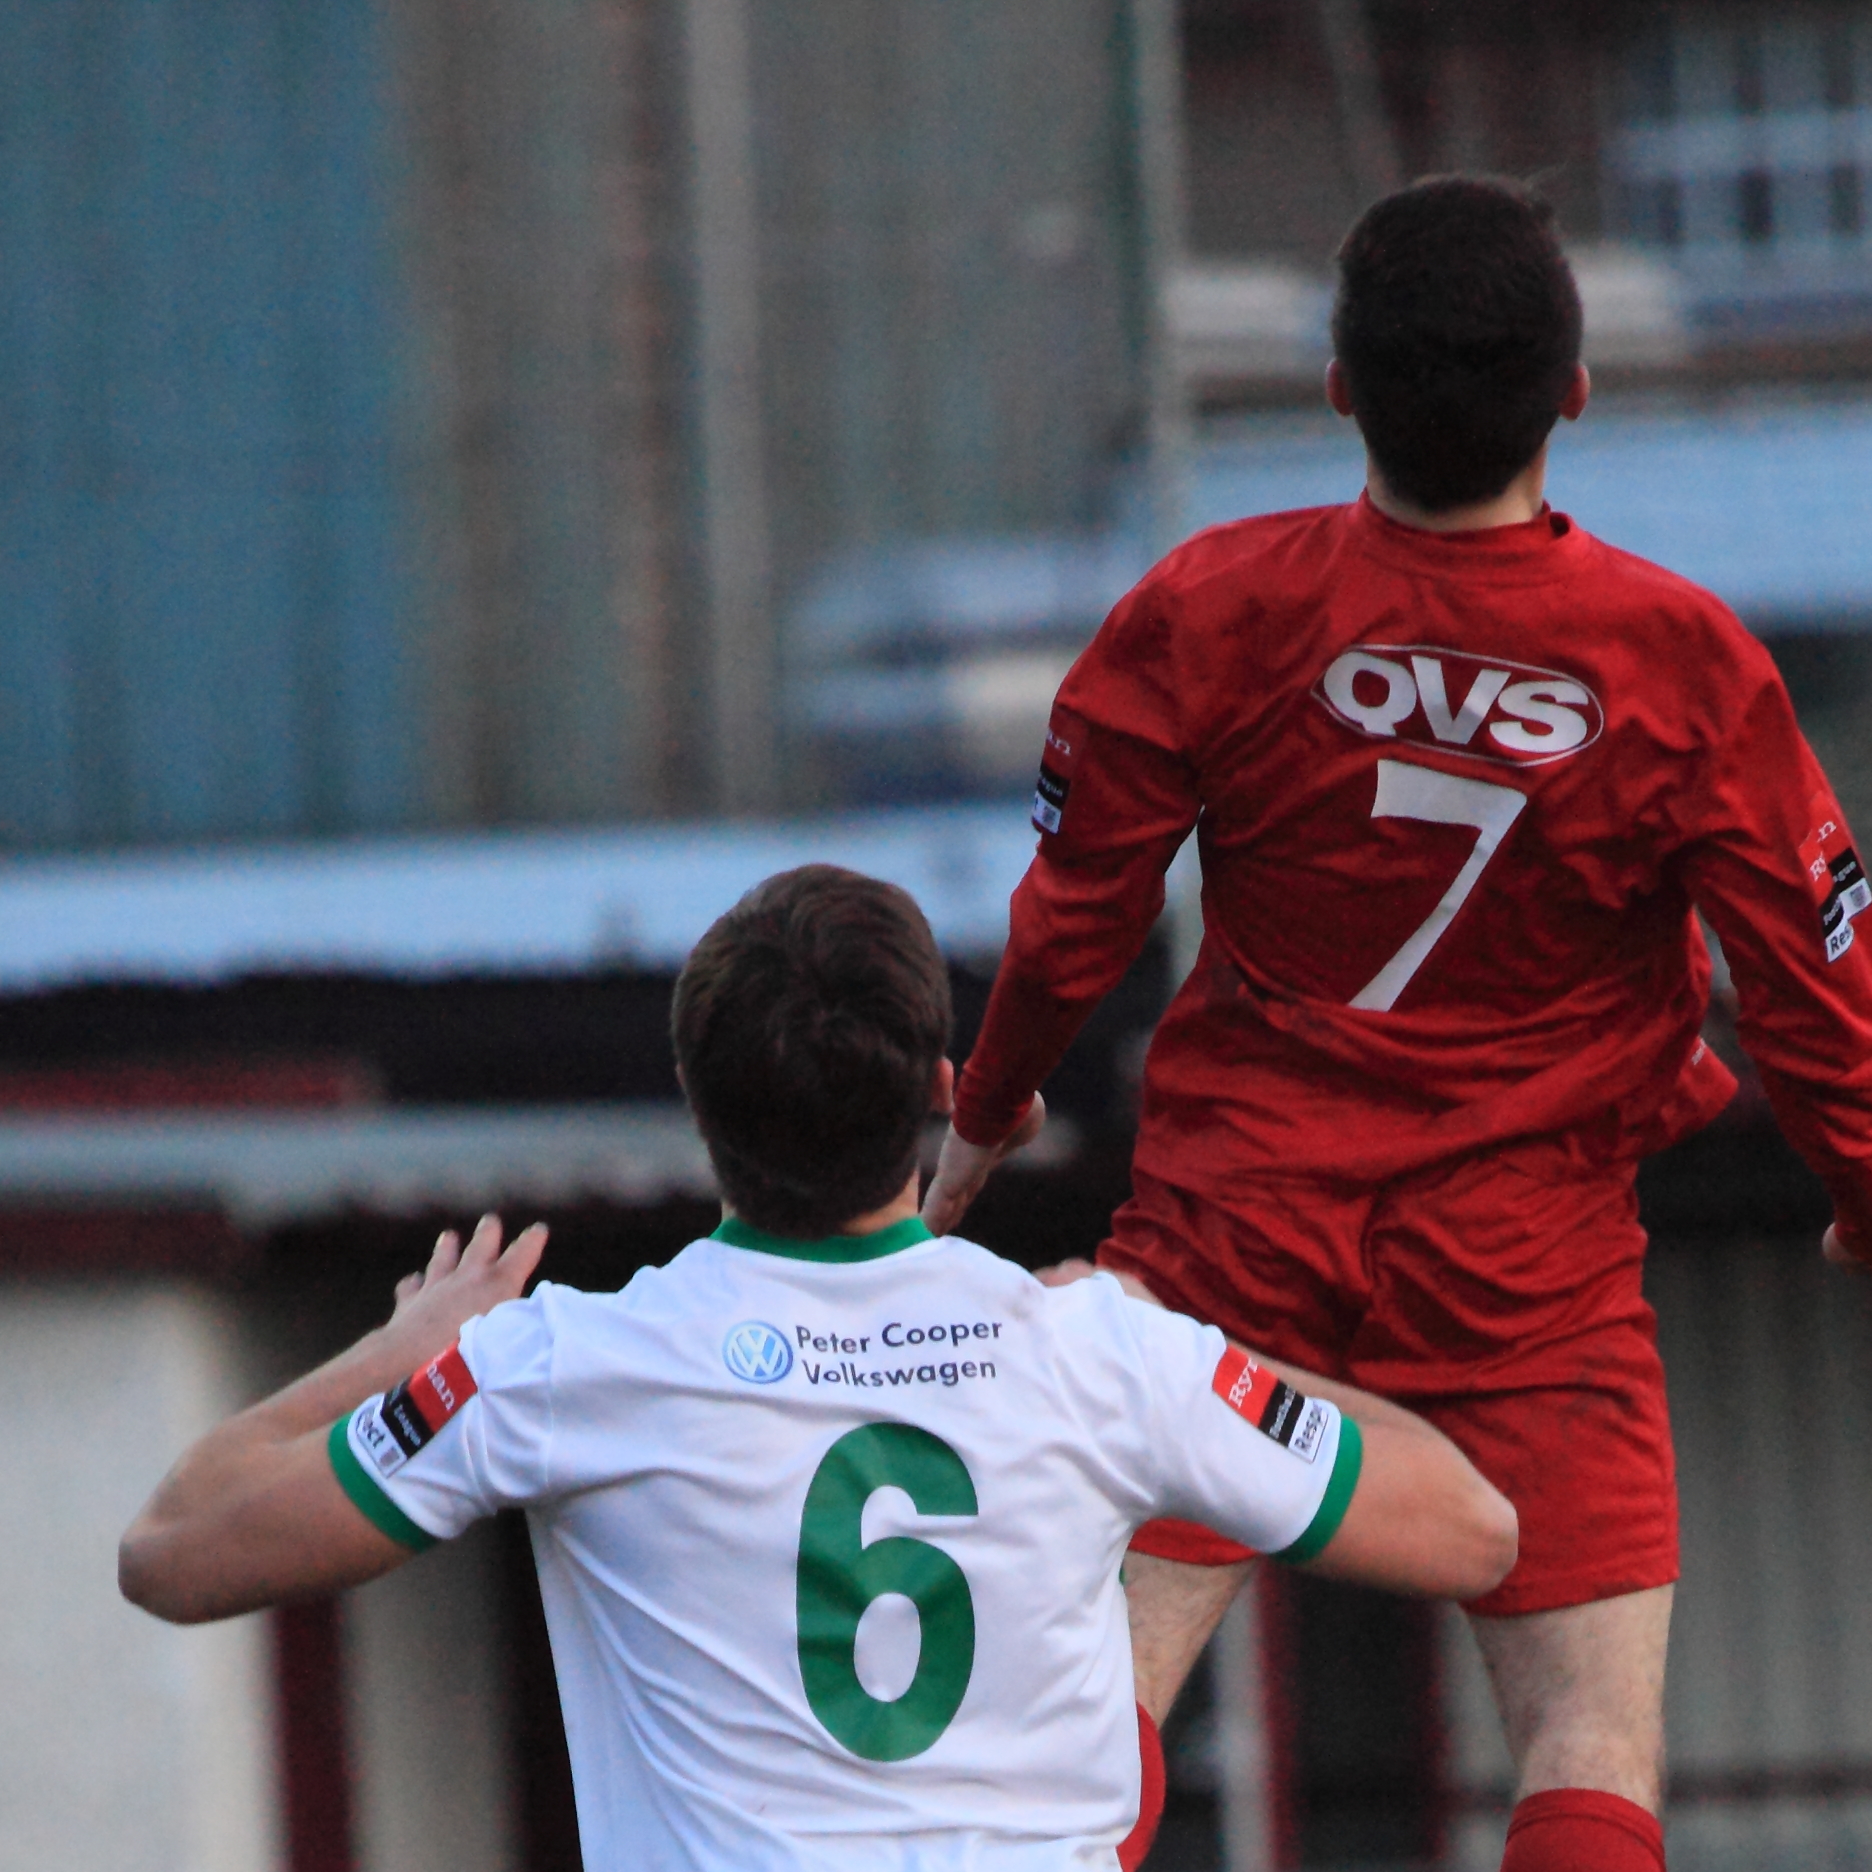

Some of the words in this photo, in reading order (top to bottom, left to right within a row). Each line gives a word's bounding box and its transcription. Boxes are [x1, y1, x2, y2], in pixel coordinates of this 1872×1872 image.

[1323, 651, 1590, 754] QVS
[1346, 758, 1528, 1013] 7
[795, 1325, 871, 1354] Peter
[881, 1321, 1003, 1348] Cooper
[801, 1359, 997, 1388] Volkswagen
[795, 1421, 980, 1763] 6
